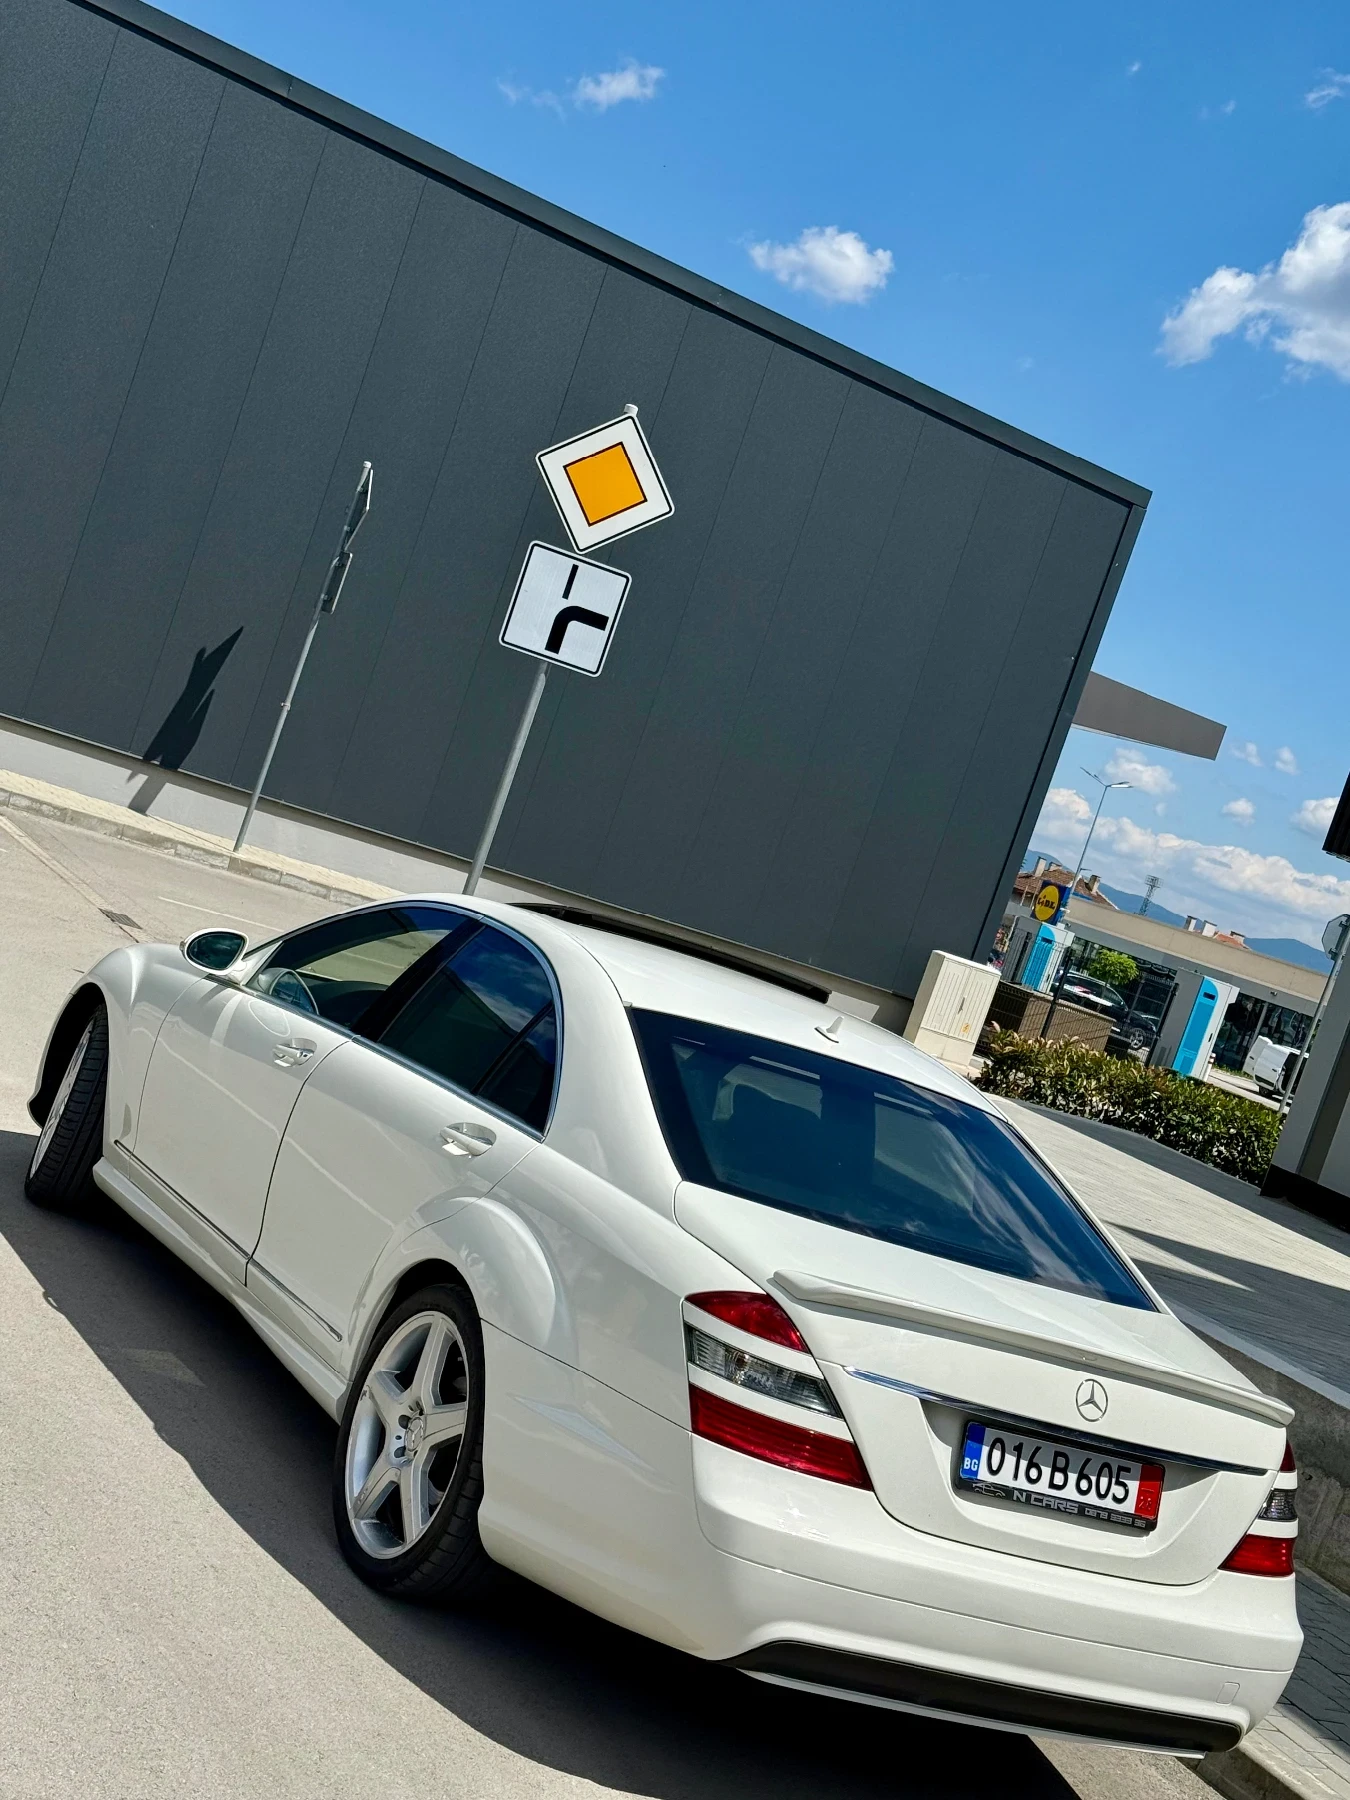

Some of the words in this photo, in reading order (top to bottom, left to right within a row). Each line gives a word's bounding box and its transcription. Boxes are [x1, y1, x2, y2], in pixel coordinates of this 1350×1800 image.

[963, 1457, 979, 1472] BG
[1012, 1490, 1028, 1503] N
[1031, 1493, 1079, 1514] CARS
